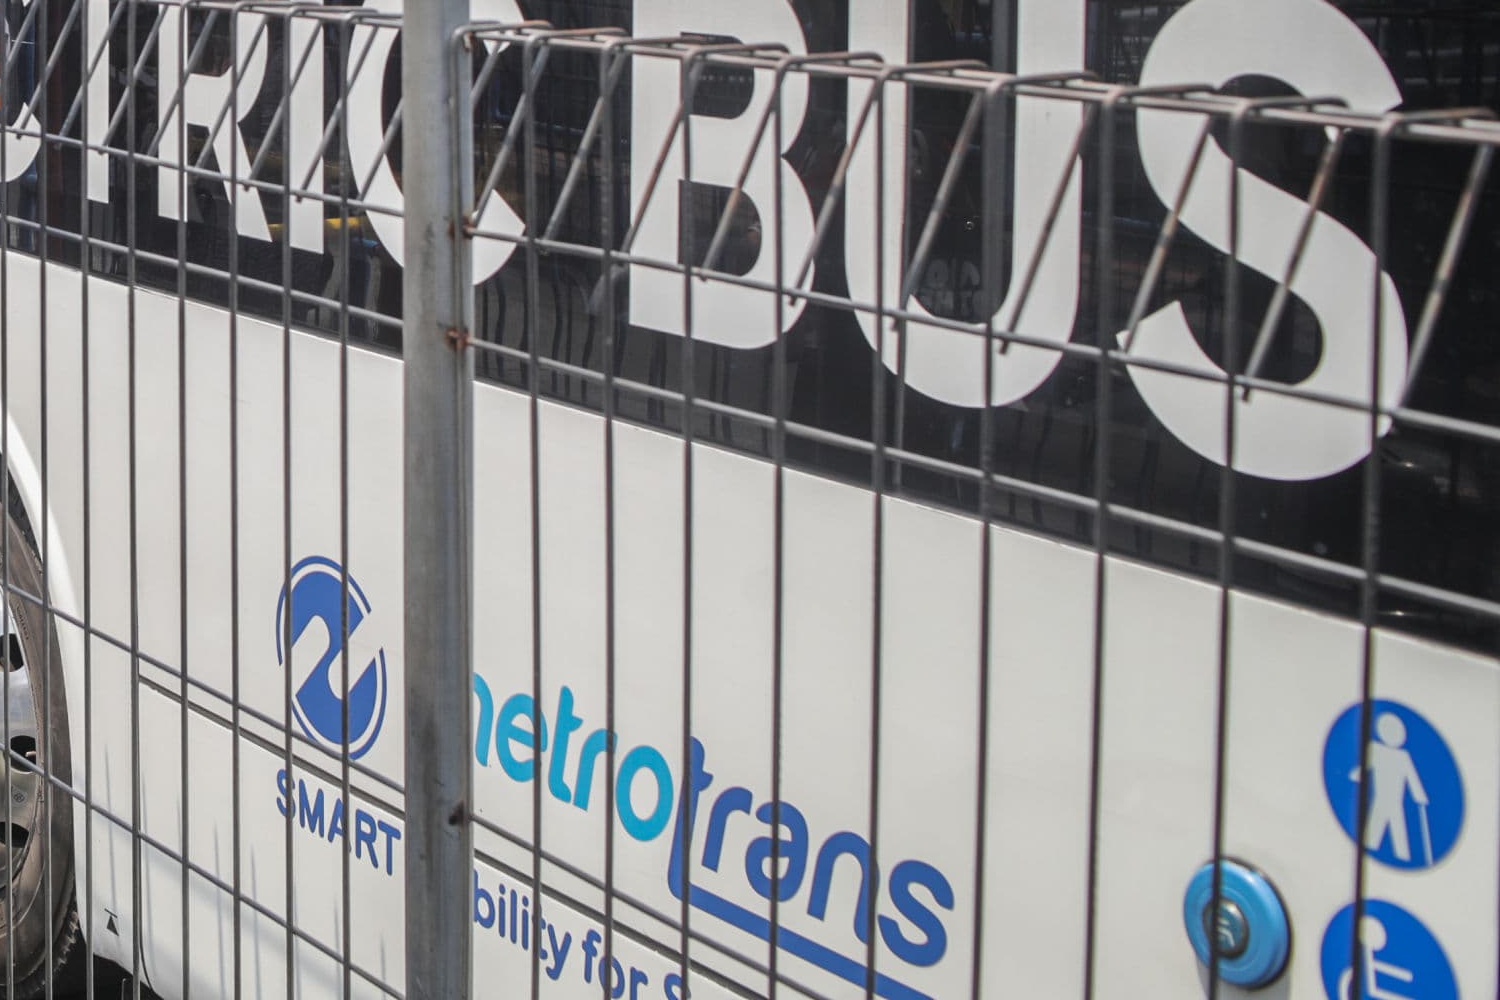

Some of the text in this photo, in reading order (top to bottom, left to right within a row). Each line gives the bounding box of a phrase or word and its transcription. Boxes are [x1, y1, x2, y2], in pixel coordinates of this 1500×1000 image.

[276, 769, 648, 1000] SMART bility for
